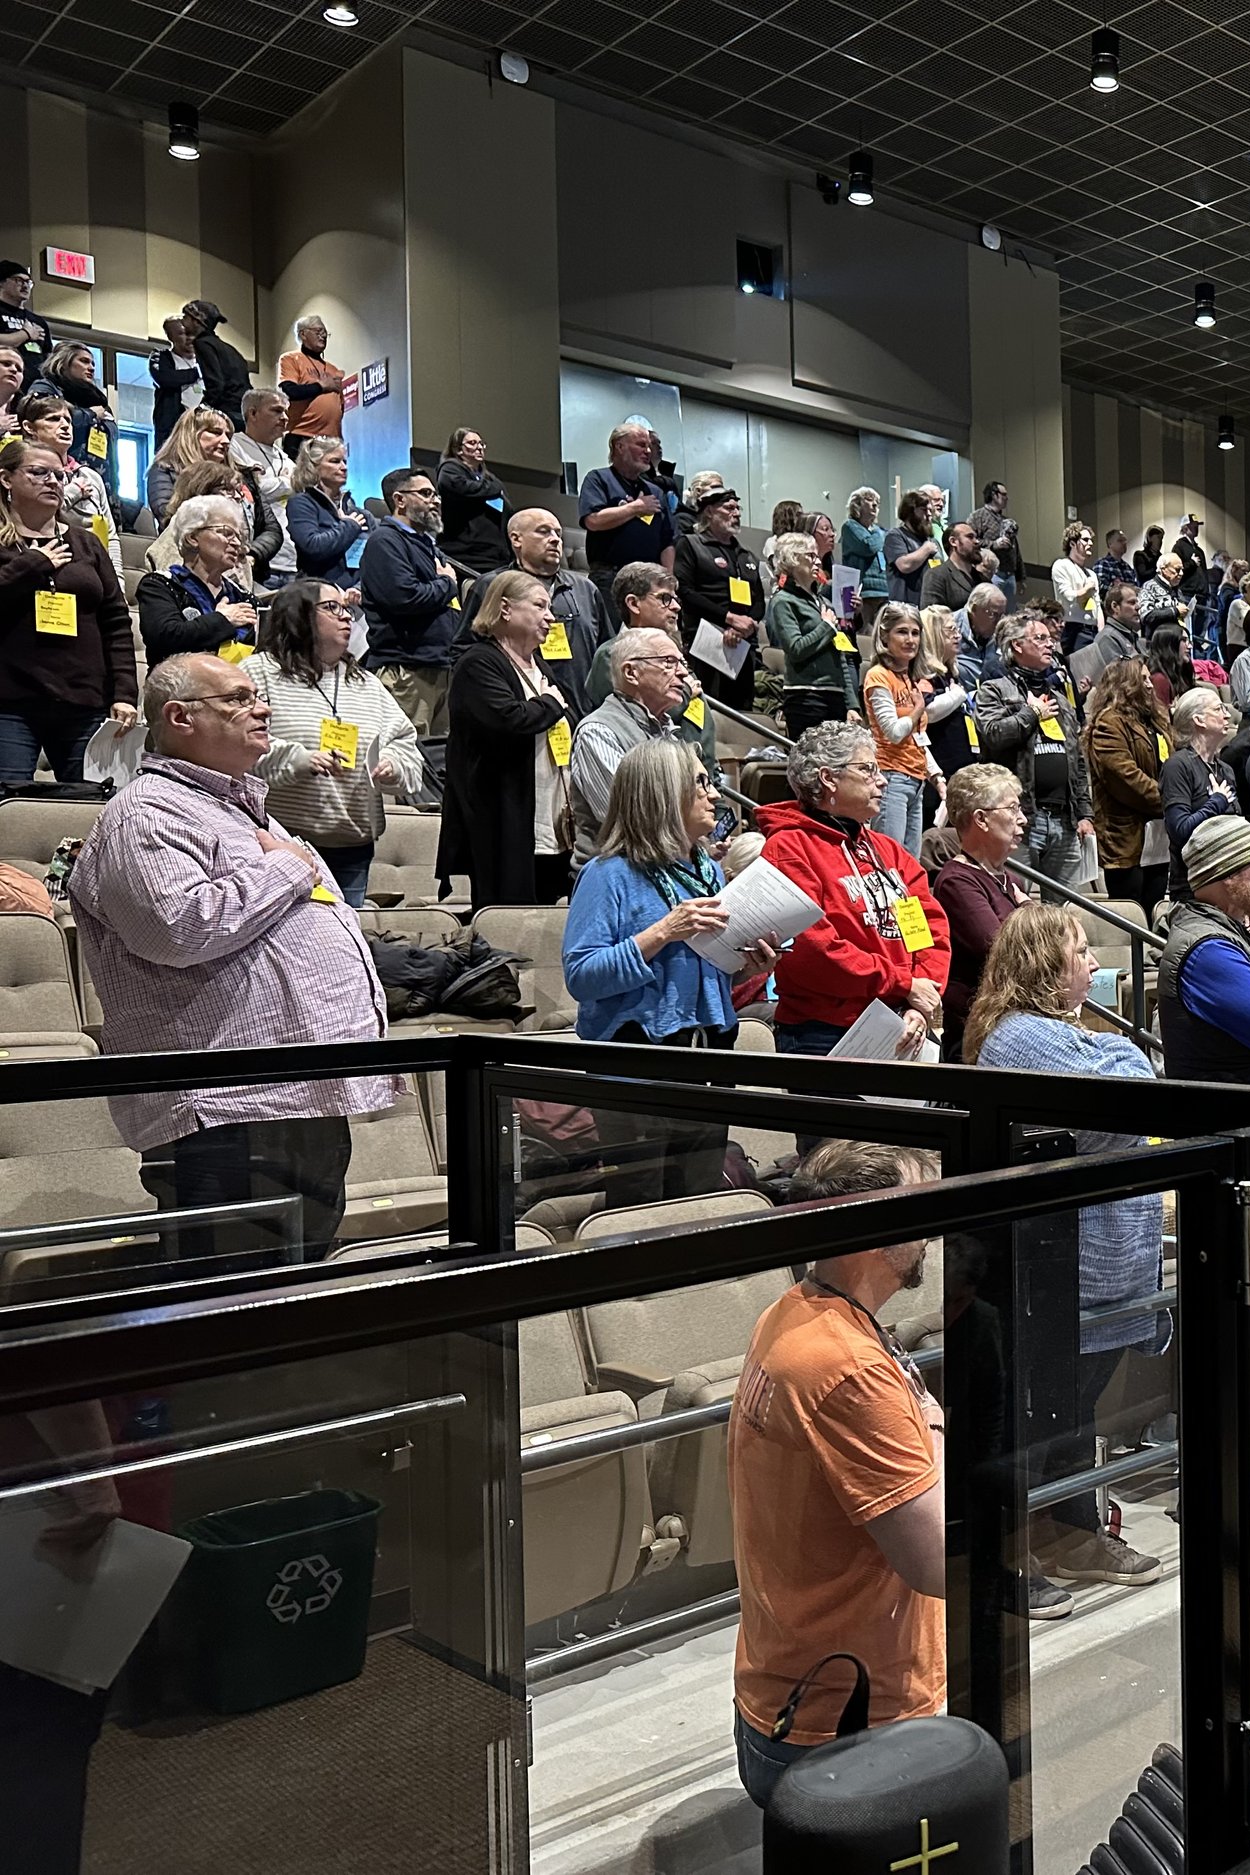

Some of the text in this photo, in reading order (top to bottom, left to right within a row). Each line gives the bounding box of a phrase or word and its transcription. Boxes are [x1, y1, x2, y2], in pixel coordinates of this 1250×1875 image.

[55, 250, 86, 278] EXIT
[363, 363, 386, 392] Little
[363, 384, 387, 402] CONGRESS
